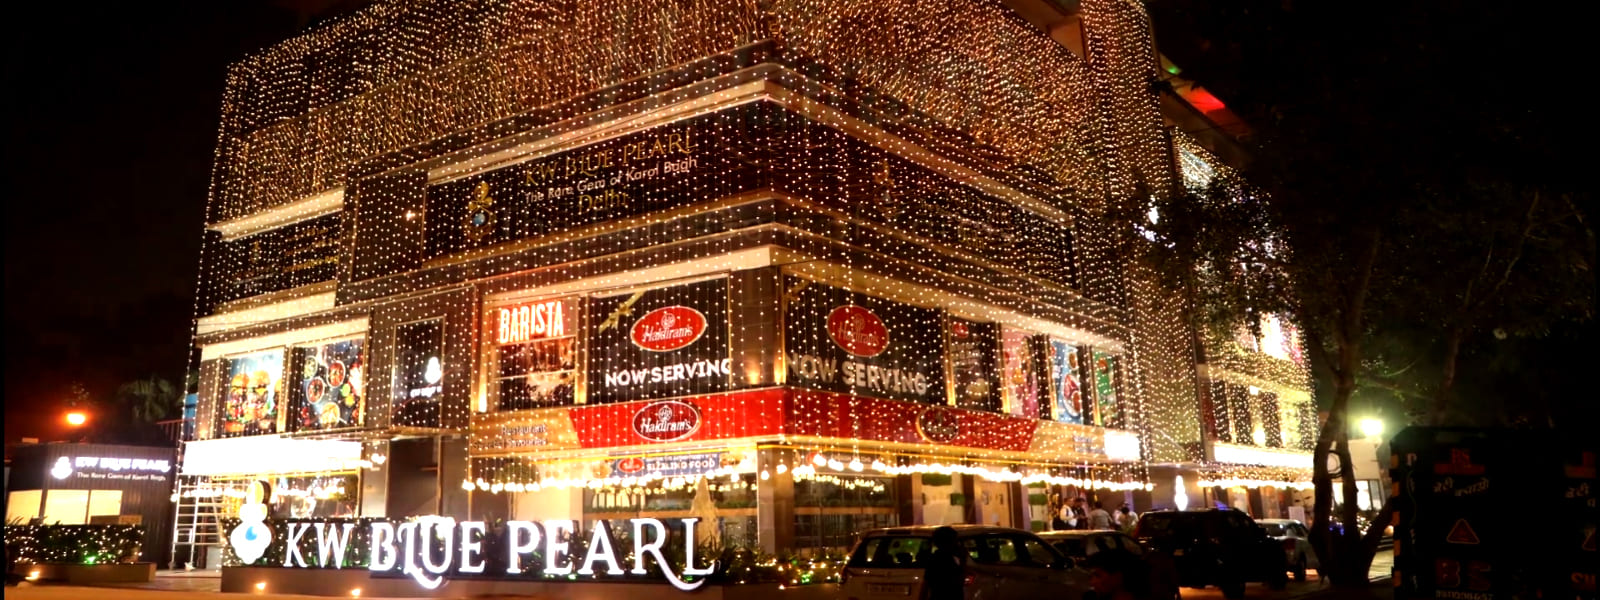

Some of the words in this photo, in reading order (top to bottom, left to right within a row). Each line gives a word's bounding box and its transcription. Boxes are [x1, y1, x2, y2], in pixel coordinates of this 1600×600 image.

[524, 161, 558, 186] KW
[565, 148, 615, 177] BLUE
[623, 130, 697, 164] PEARL
[524, 191, 545, 204] The
[548, 185, 574, 200] Rare
[577, 178, 606, 192] Gem
[626, 165, 659, 181] Karol
[664, 156, 698, 174] Bagh
[578, 187, 628, 214] Delhi
[499, 300, 564, 344] BARISTA
[642, 325, 694, 343] Haldiram's
[604, 367, 648, 388] NOW
[785, 352, 836, 384] NOW
[841, 360, 927, 396] SERVING
[640, 417, 692, 433] Haldiram's
[689, 457, 716, 468] FOOD
[284, 521, 355, 569] KW
[368, 515, 487, 590] BLUE
[506, 517, 715, 591] PEARL
